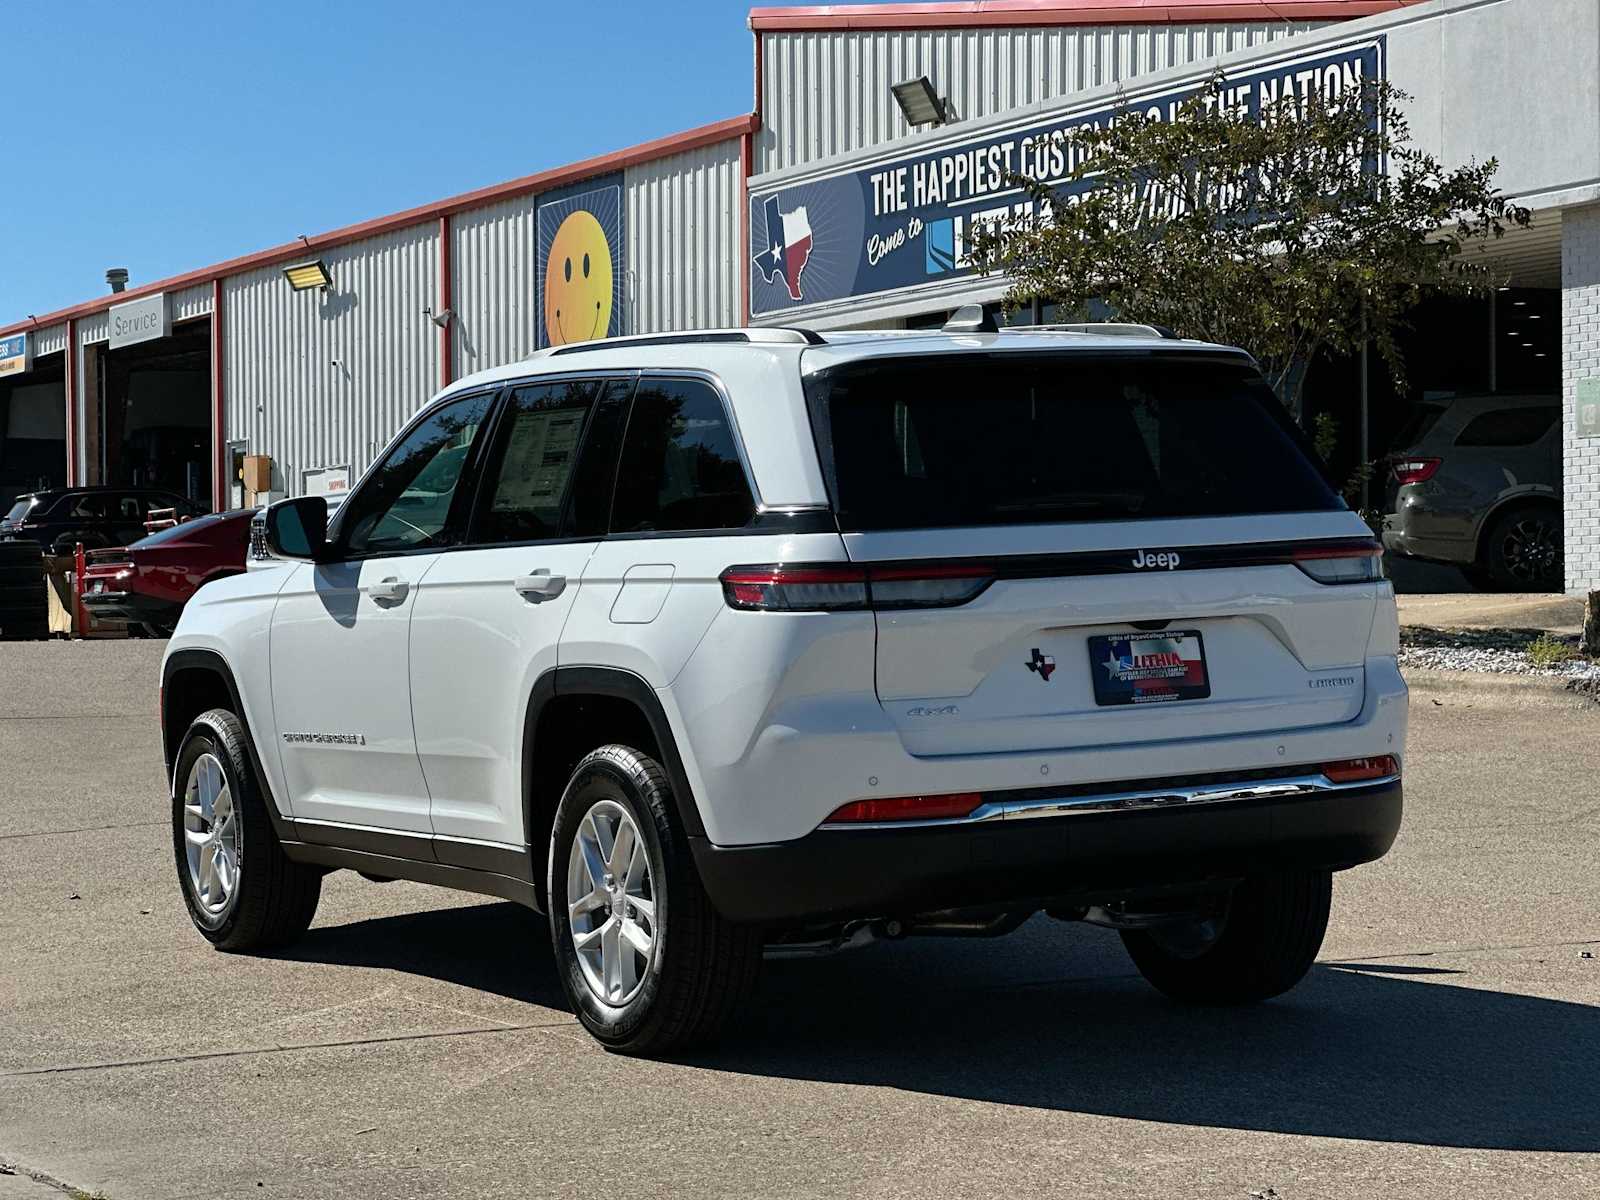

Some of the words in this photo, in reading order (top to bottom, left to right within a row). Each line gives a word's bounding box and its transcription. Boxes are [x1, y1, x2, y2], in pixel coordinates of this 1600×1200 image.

[870, 167, 908, 216] THE
[913, 141, 1015, 208] HAPPIEST
[1260, 57, 1362, 129] NATION
[866, 227, 905, 266] Come
[908, 217, 924, 240] to
[115, 311, 157, 337] Service
[1132, 549, 1180, 570] Jeep
[1133, 651, 1183, 669] LITHIA
